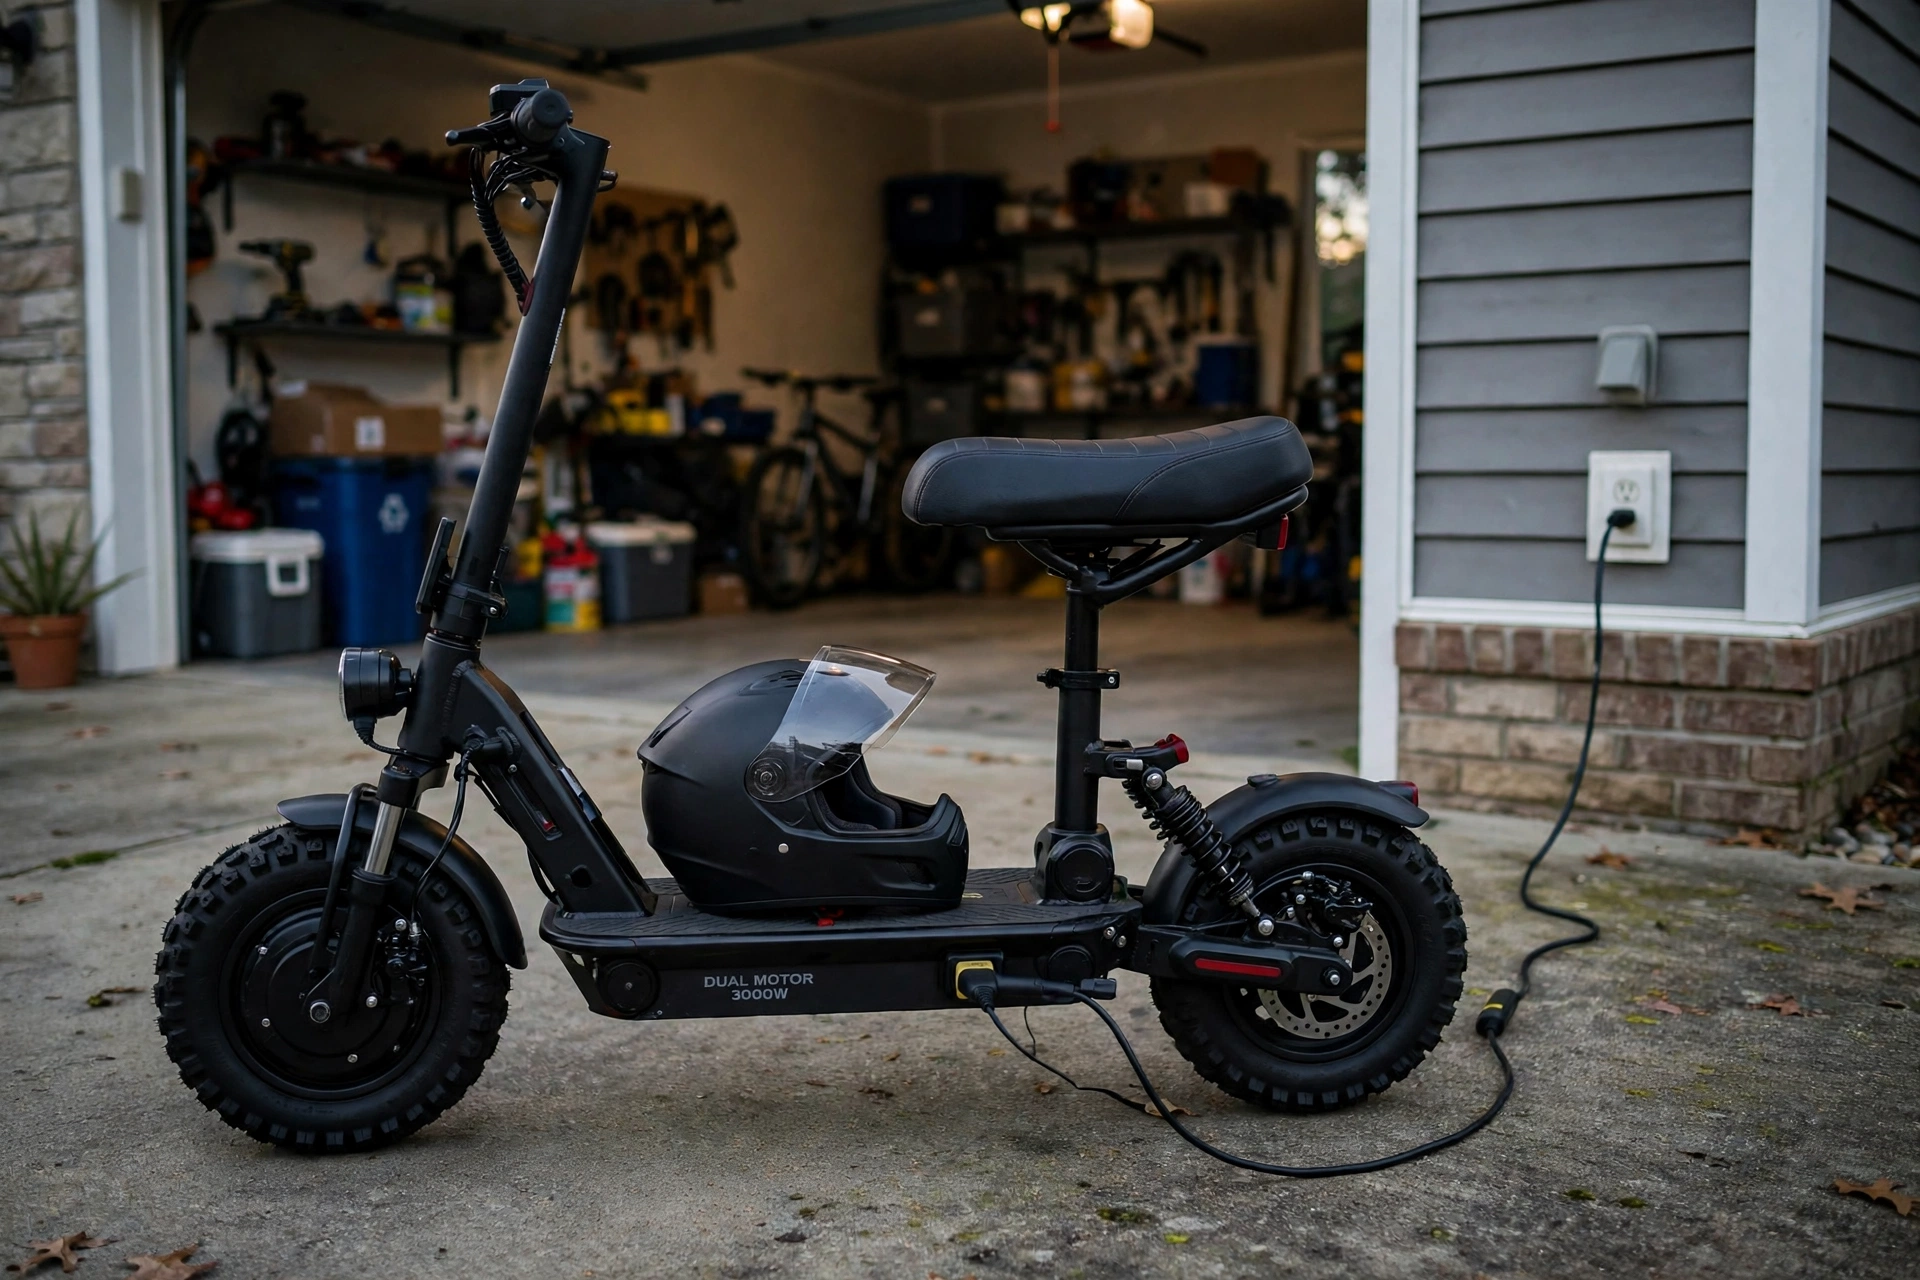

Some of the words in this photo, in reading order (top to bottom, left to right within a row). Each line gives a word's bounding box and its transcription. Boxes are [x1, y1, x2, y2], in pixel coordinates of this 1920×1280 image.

[704, 975, 749, 988] DUAL
[754, 973, 814, 986] MOTOR
[731, 988, 788, 1001] 3000W
